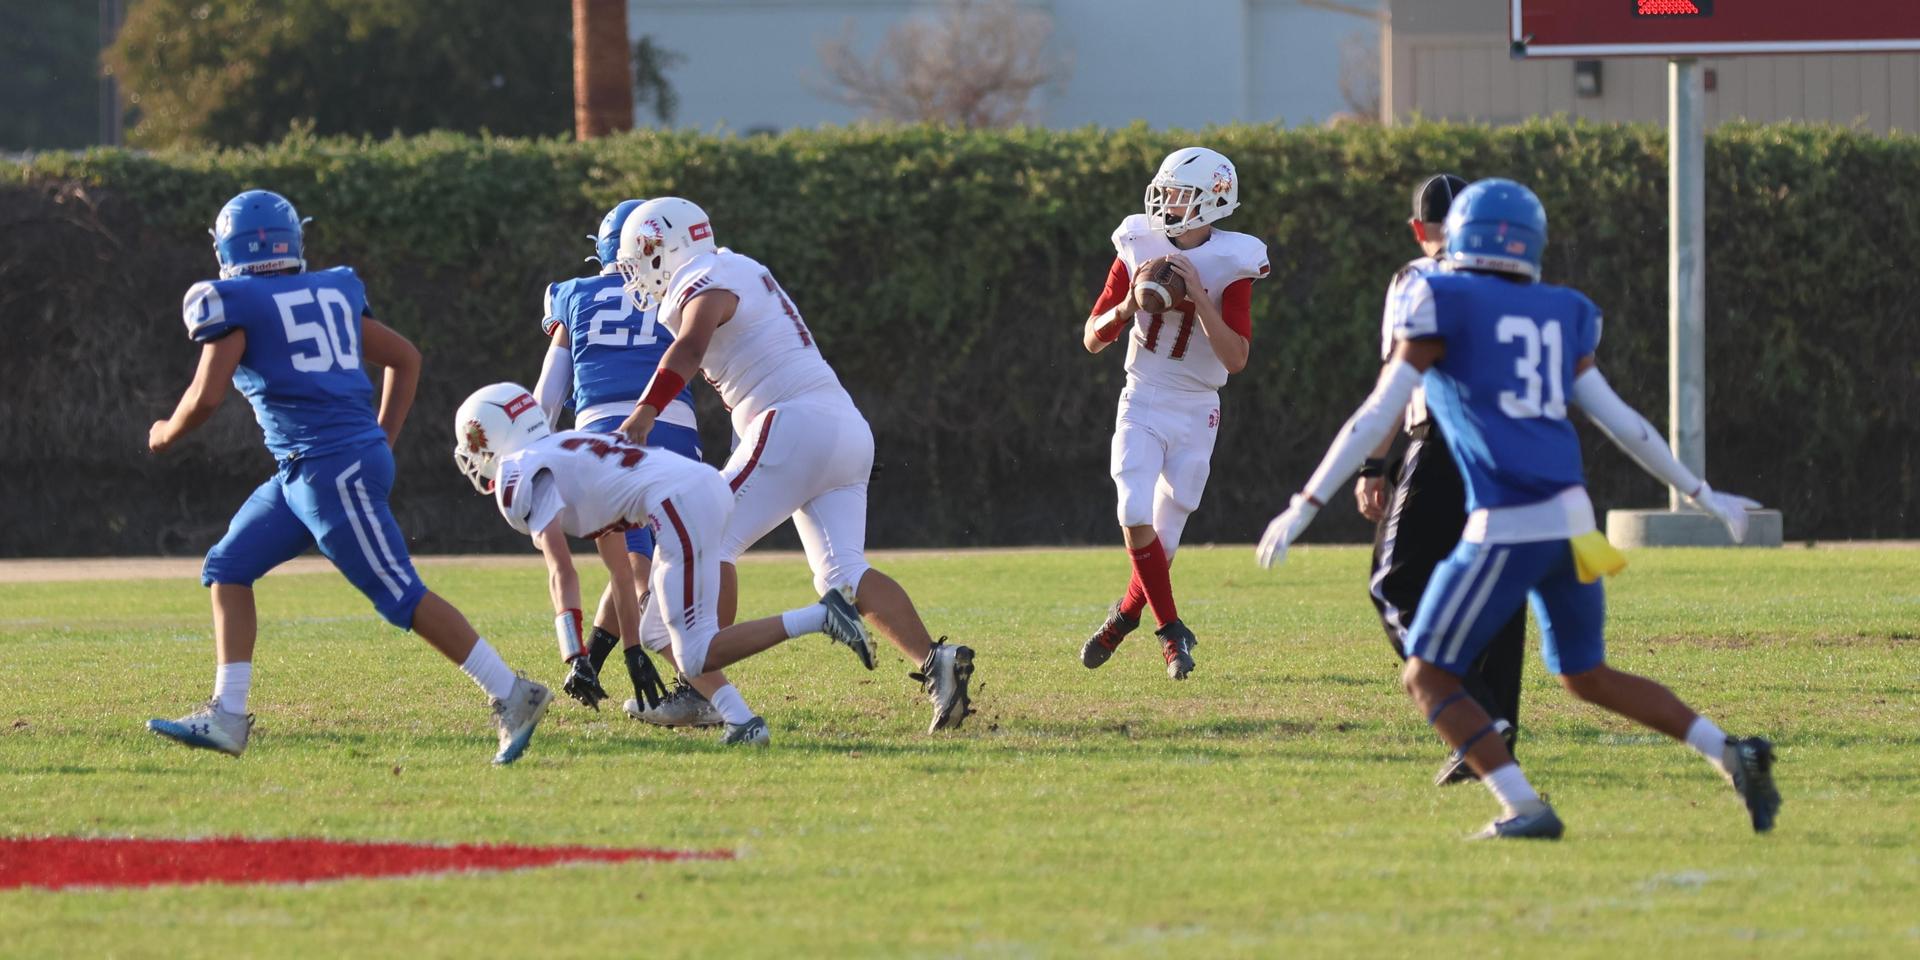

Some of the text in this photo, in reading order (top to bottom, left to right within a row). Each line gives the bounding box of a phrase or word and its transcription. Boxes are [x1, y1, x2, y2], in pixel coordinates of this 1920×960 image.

[272, 287, 360, 373] 50
[586, 286, 658, 346] 21
[1144, 298, 1197, 361] 17
[1496, 315, 1567, 420] 31
[559, 432, 647, 470] 3
